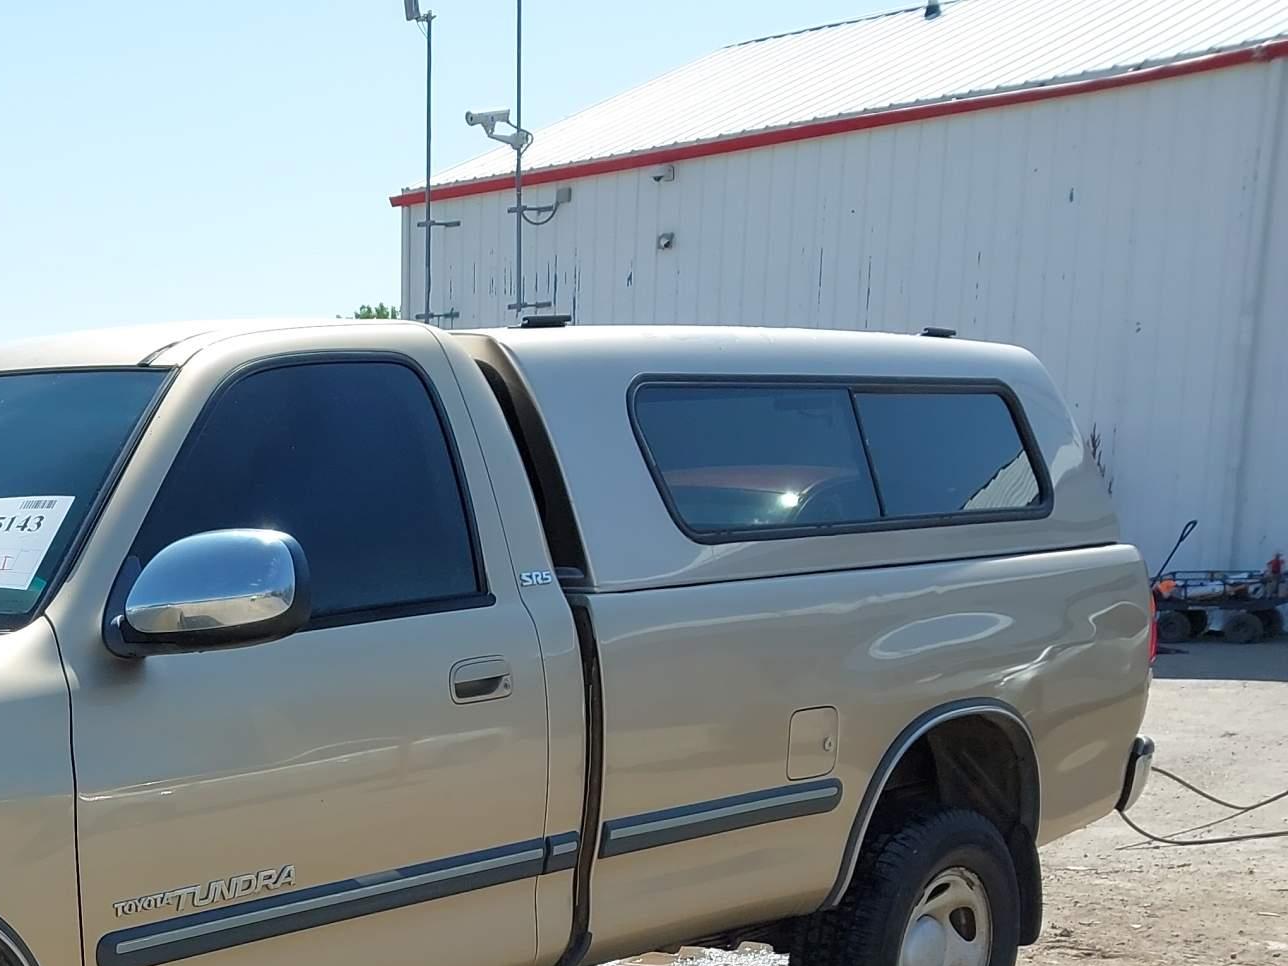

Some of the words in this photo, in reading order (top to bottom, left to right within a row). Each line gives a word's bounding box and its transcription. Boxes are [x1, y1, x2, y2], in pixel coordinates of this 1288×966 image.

[520, 570, 552, 587] SR5
[113, 891, 172, 917] TOYOTA
[171, 864, 297, 912] TUNDRA
